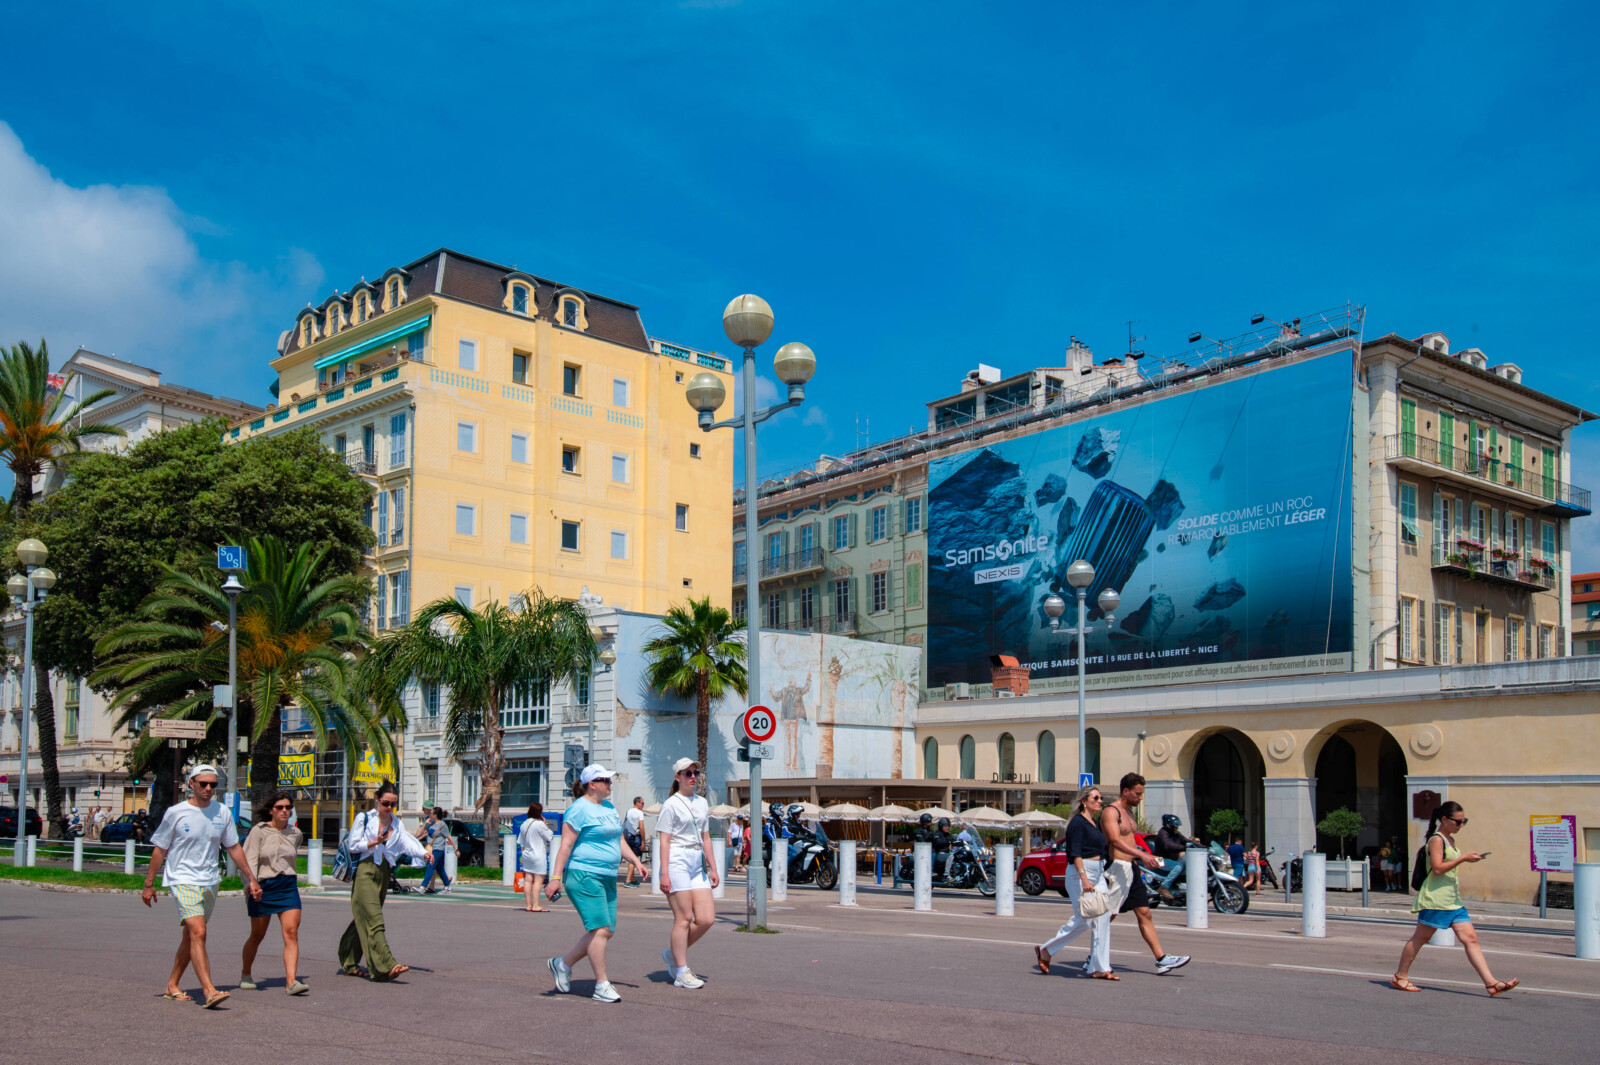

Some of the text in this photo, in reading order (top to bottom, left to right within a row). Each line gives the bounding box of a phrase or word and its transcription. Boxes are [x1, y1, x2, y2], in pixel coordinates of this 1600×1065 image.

[1167, 507, 1326, 545] REMARQUABLEMENT LÉGER
[1177, 495, 1313, 531] SOLIDE COMME UN ROC
[945, 535, 1049, 568] Samsonite
[977, 566, 1021, 581] NEXIS
[1117, 653, 1132, 661] RUE
[1133, 652, 1144, 660] DE
[1145, 651, 1156, 659] LA
[1157, 647, 1190, 658] LIBERTÉ
[1198, 645, 1219, 654] NICE
[1073, 678, 1093, 688] peues
[1093, 677, 1101, 686] par
[1101, 675, 1106, 684] le
[1106, 674, 1135, 686] propriétaire
[1135, 673, 1143, 681] du
[1143, 671, 1170, 680] monument
[1171, 670, 1184, 680] pour
[1185, 669, 1194, 677] cet
[1194, 666, 1219, 678] affichage
[1220, 665, 1233, 675] sont
[1233, 663, 1260, 674] affectées
[1269, 657, 1306, 671] financement
[1307, 658, 1319, 667] des
[1320, 657, 1345, 666] travaux
[751, 717, 769, 730] 20
